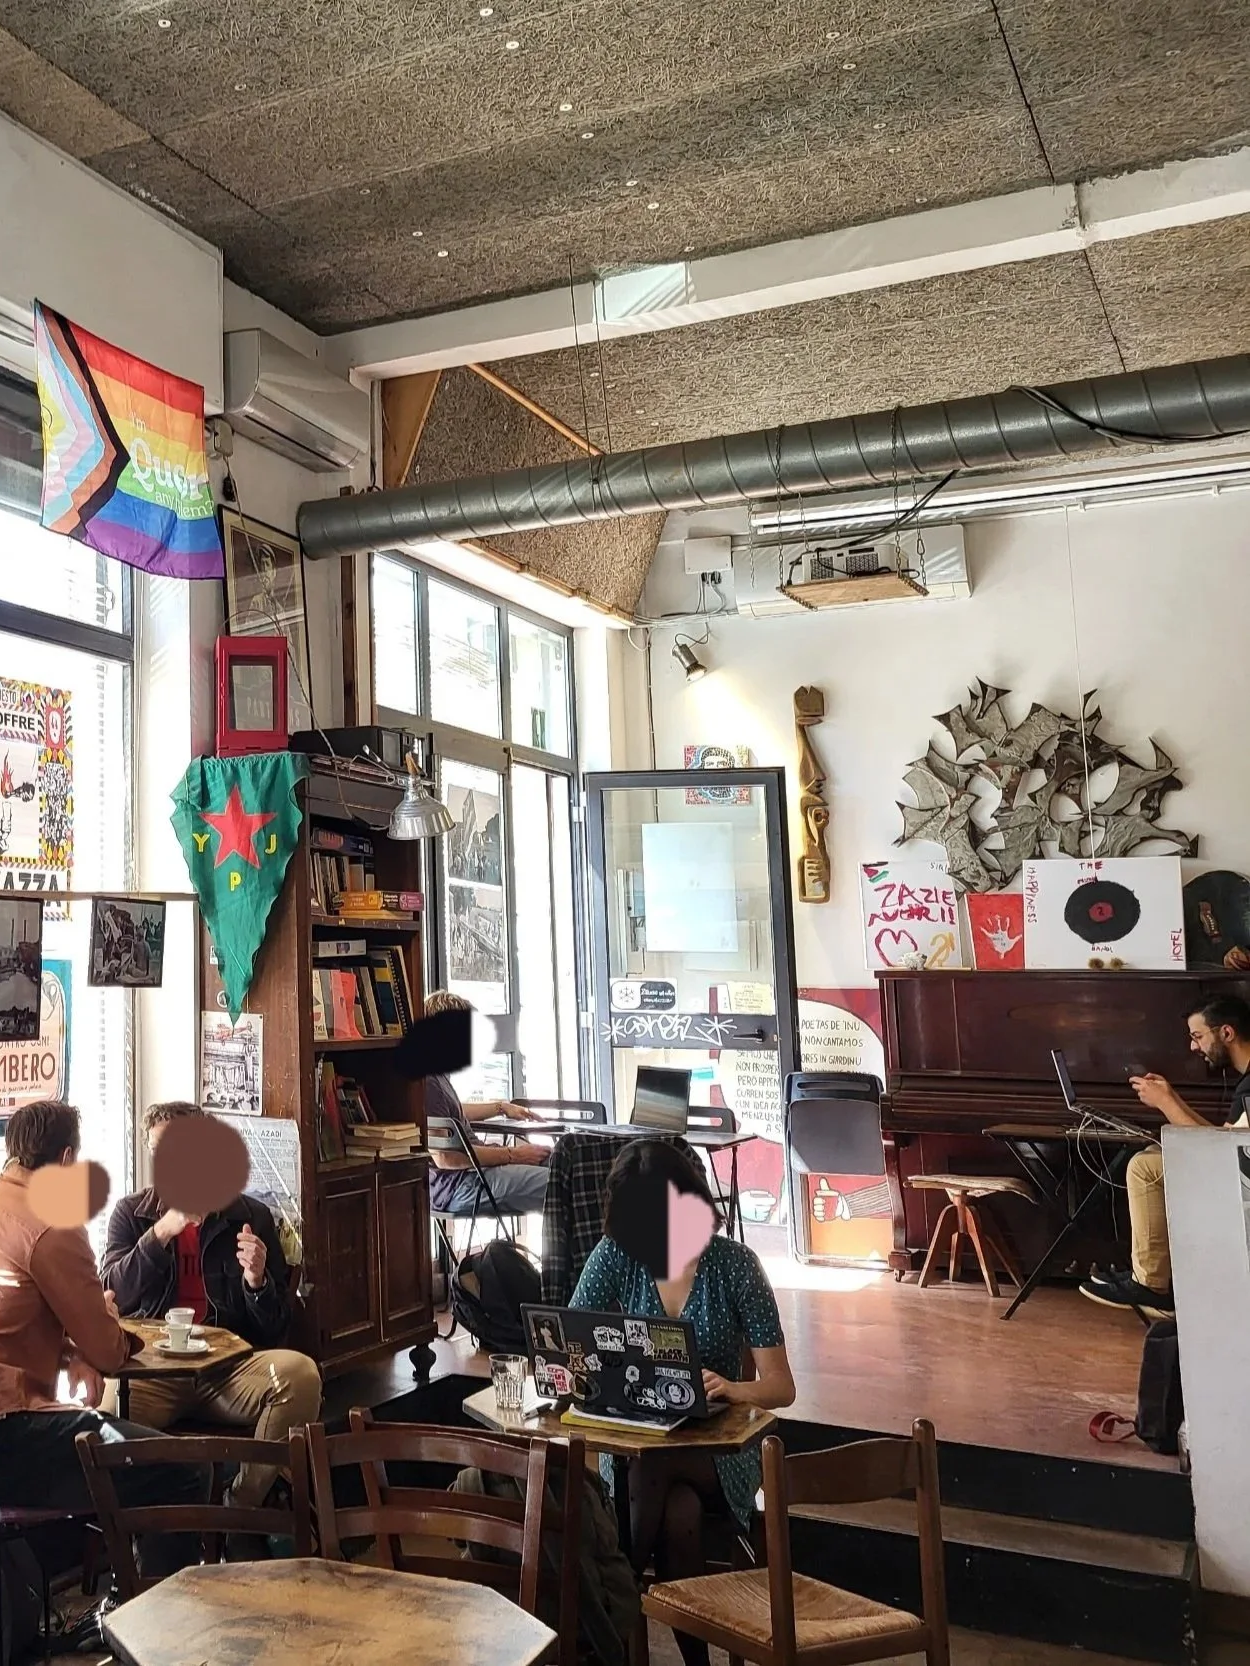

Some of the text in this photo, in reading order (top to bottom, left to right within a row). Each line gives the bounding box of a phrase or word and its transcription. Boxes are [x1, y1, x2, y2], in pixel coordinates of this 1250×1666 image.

[192, 833, 278, 855] Y J
[229, 871, 242, 892] P
[874, 880, 955, 908] ZAZIE
[1170, 927, 1184, 962] HOTEL
[260, 1129, 282, 1138] AZADI
